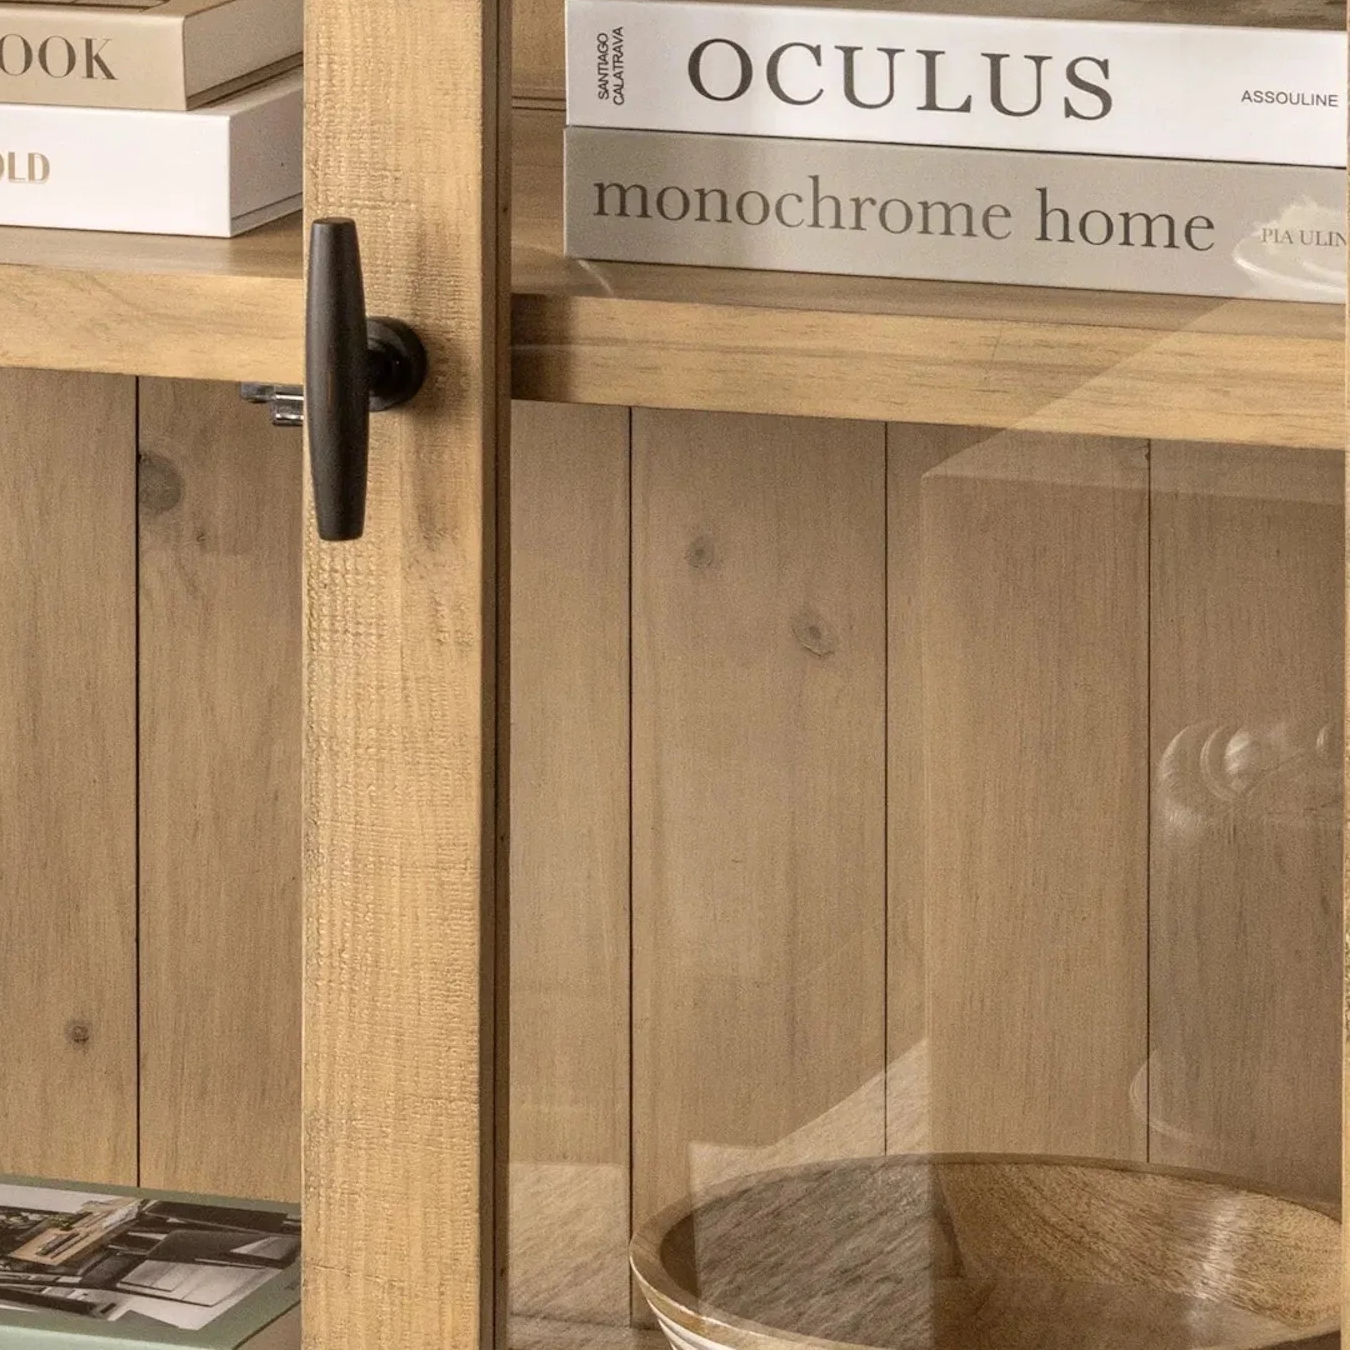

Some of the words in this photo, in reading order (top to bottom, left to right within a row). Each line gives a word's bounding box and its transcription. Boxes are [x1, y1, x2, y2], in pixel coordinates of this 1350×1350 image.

[597, 32, 610, 100] SANTIAGO
[612, 26, 625, 106] CALATRAVA
[687, 38, 1114, 121] OCULUS
[1240, 90, 1339, 107] ASSOULINE
[592, 175, 1013, 241] monochrome
[1035, 187, 1216, 252] home
[1259, 228, 1294, 244] PIA
